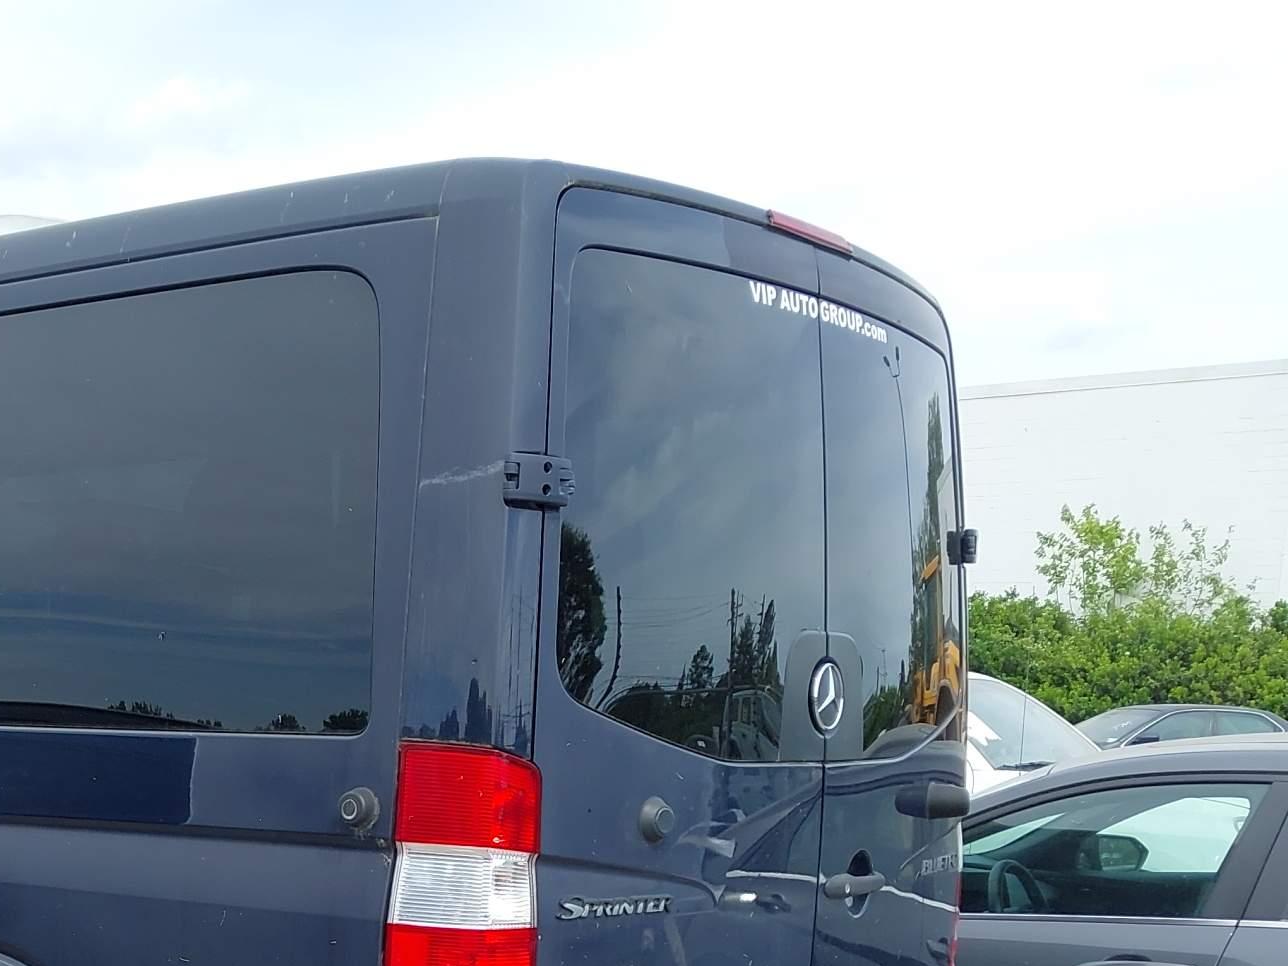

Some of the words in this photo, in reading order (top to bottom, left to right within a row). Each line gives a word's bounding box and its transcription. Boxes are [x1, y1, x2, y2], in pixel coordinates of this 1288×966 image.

[749, 280, 777, 306] VIP
[780, 289, 818, 318] AUTO
[820, 301, 887, 343] GROUP.com
